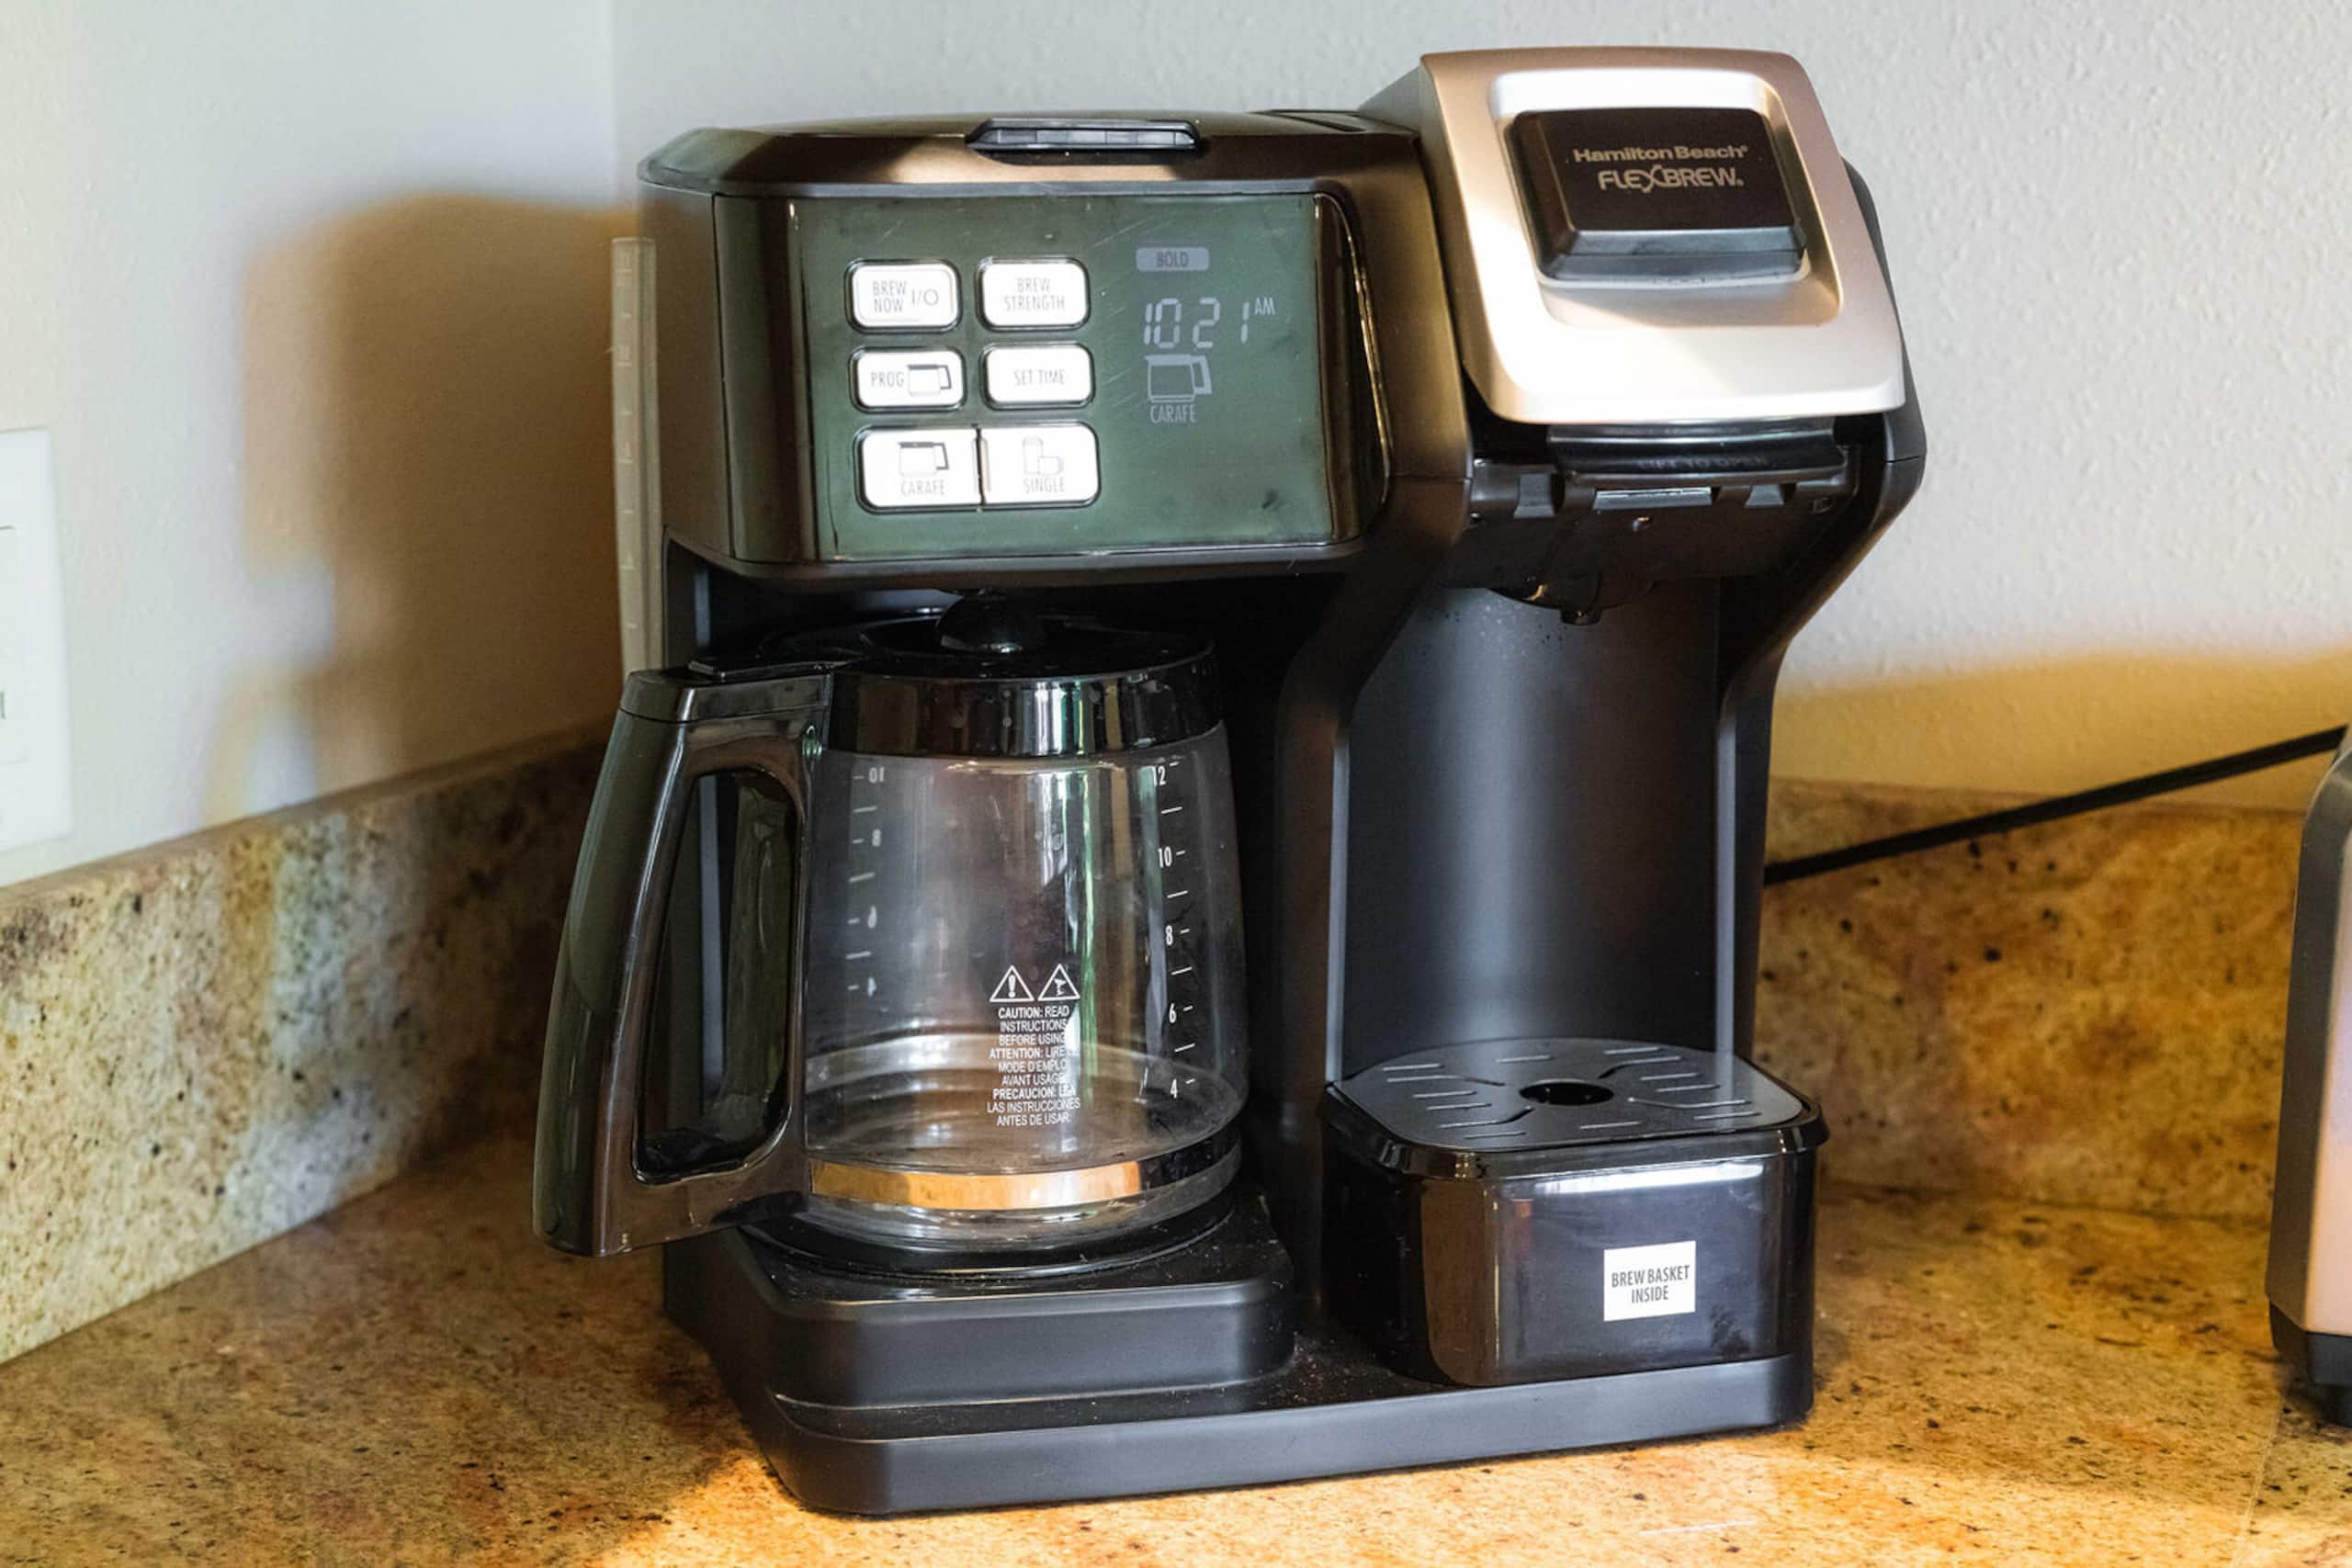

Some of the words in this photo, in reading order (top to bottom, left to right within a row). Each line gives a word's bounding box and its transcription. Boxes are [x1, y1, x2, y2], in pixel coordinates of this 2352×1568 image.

[1572, 147, 1672, 163] Hamilton
[1156, 251, 1189, 267] BOLD
[872, 279, 908, 297] BREW
[1016, 277, 1052, 294] BREW
[874, 297, 905, 314] NOW
[1002, 294, 1066, 312] STRENGTH
[1254, 297, 1276, 316] AM
[870, 370, 905, 388] PROG
[1013, 369, 1035, 386] SET
[1038, 368, 1066, 385] TIME
[1149, 403, 1197, 424] CARAFE
[900, 479, 946, 496] CARAFE
[1023, 476, 1066, 494] SINGLE
[1152, 765, 1167, 786] 12
[1158, 845, 1172, 868] 10
[1165, 924, 1174, 946] 8
[998, 1007, 1043, 1020] CAUTION:
[1045, 1005, 1069, 1018] READ
[1169, 1002, 1178, 1024] 6
[1000, 1019, 1068, 1032] INSTRUCTIONS
[999, 1033, 1037, 1046] BEFORE
[1038, 1032, 1066, 1045] USING
[989, 1047, 1044, 1060] ATTENTION:
[998, 1060, 1026, 1073] MODE
[1027, 1058, 1070, 1073] D'EMPLO
[1001, 1074, 1032, 1087] AVANT
[1170, 1078, 1179, 1100] 4
[987, 1101, 1005, 1113] LAS
[1007, 1097, 1081, 1112] INSTRUCCIONES
[996, 1113, 1028, 1126] ANTES
[1029, 1113, 1043, 1126] DE
[1044, 1111, 1070, 1125] USAR
[1611, 1269, 1645, 1288] BREW
[1647, 1265, 1690, 1284] BASKET
[1631, 1285, 1669, 1304] INSIDE
